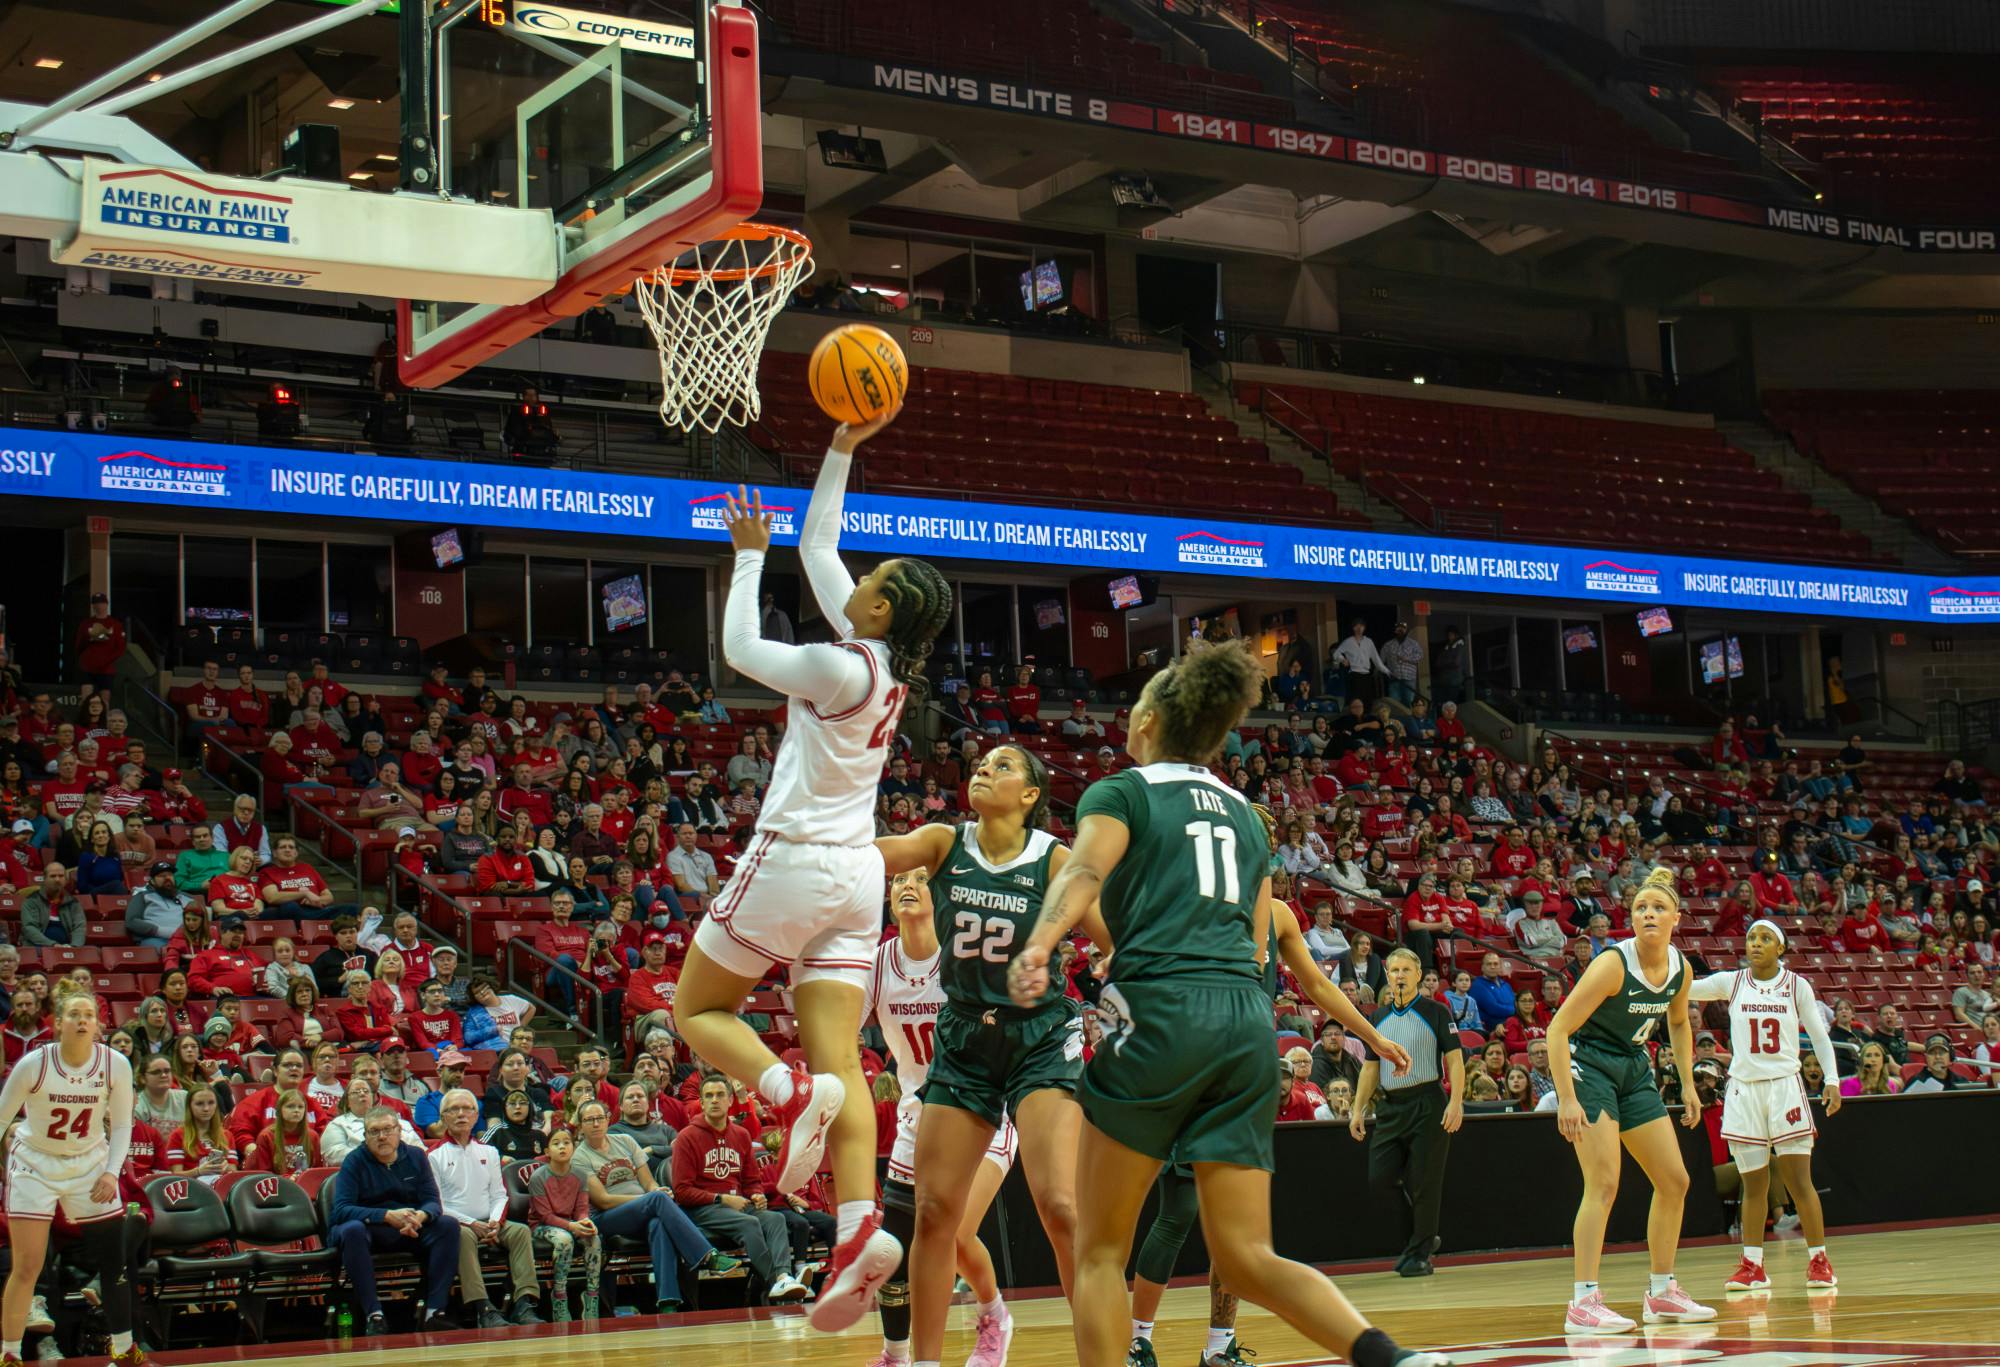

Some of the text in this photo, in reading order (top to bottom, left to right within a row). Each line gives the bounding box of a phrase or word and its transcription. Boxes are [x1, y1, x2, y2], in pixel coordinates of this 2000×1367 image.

[577, 20, 694, 49] COOPERTIR
[874, 65, 1108, 122] MEN'S ELITE 8
[1172, 113, 1238, 142] 1941
[1268, 128, 1333, 156] 1947
[1356, 142, 1426, 172] 2000
[1446, 156, 1514, 185] 2005
[1535, 170, 1595, 197] 2014
[1618, 183, 1677, 209] 2015
[102, 187, 289, 224] AMERICAN FAMILY
[115, 210, 276, 239] INSURANCE
[1768, 208, 1996, 249] MEN'S FINAL FOUR
[88, 252, 312, 281] AMERICAN FAMILY
[912, 330, 932, 342] 209
[0, 451, 56, 476] SSLY
[102, 464, 224, 484] AMERICAN FAMILY
[111, 478, 216, 492] INSURANCE
[271, 468, 654, 518] INSURE CAREFULLY, DREAM FEARLESSLY
[700, 521, 785, 532] INSCE
[839, 510, 1148, 553] NSURE CAREFULLY, DREAM FEARLESSLY
[1178, 543, 1262, 558] AMERICAN FAMILY
[1184, 554, 1258, 566] INSURANCE
[1294, 544, 1560, 582] INSURE CAREFULLY, DREAM FEARLESSLY
[1586, 572, 1658, 585] AMERICAN FAMILY
[1589, 581, 1655, 594] INSURANCE
[1684, 573, 1909, 607] INSURE CAREFULLY, DREAM FEARLESSLY
[420, 590, 442, 604] 108
[1931, 597, 1972, 606] AMERICAN
[1091, 626, 1108, 638] 109
[1622, 654, 1636, 666] 110
[1190, 788, 1228, 816] TATE
[1185, 820, 1240, 904] 11
[950, 885, 1028, 914] SPARTANS
[953, 910, 1016, 963] 22
[888, 1002, 940, 1016] WISCONSI
[1741, 1004, 1788, 1014] WISCONSIN
[1632, 1018, 1656, 1046] 4
[1748, 1018, 1781, 1054] 13
[48, 1094, 100, 1104] WISCONSIN
[46, 1108, 93, 1140] 24
[1786, 1106, 1802, 1126] W
[164, 1179, 188, 1204] W
[256, 1176, 278, 1200] W
